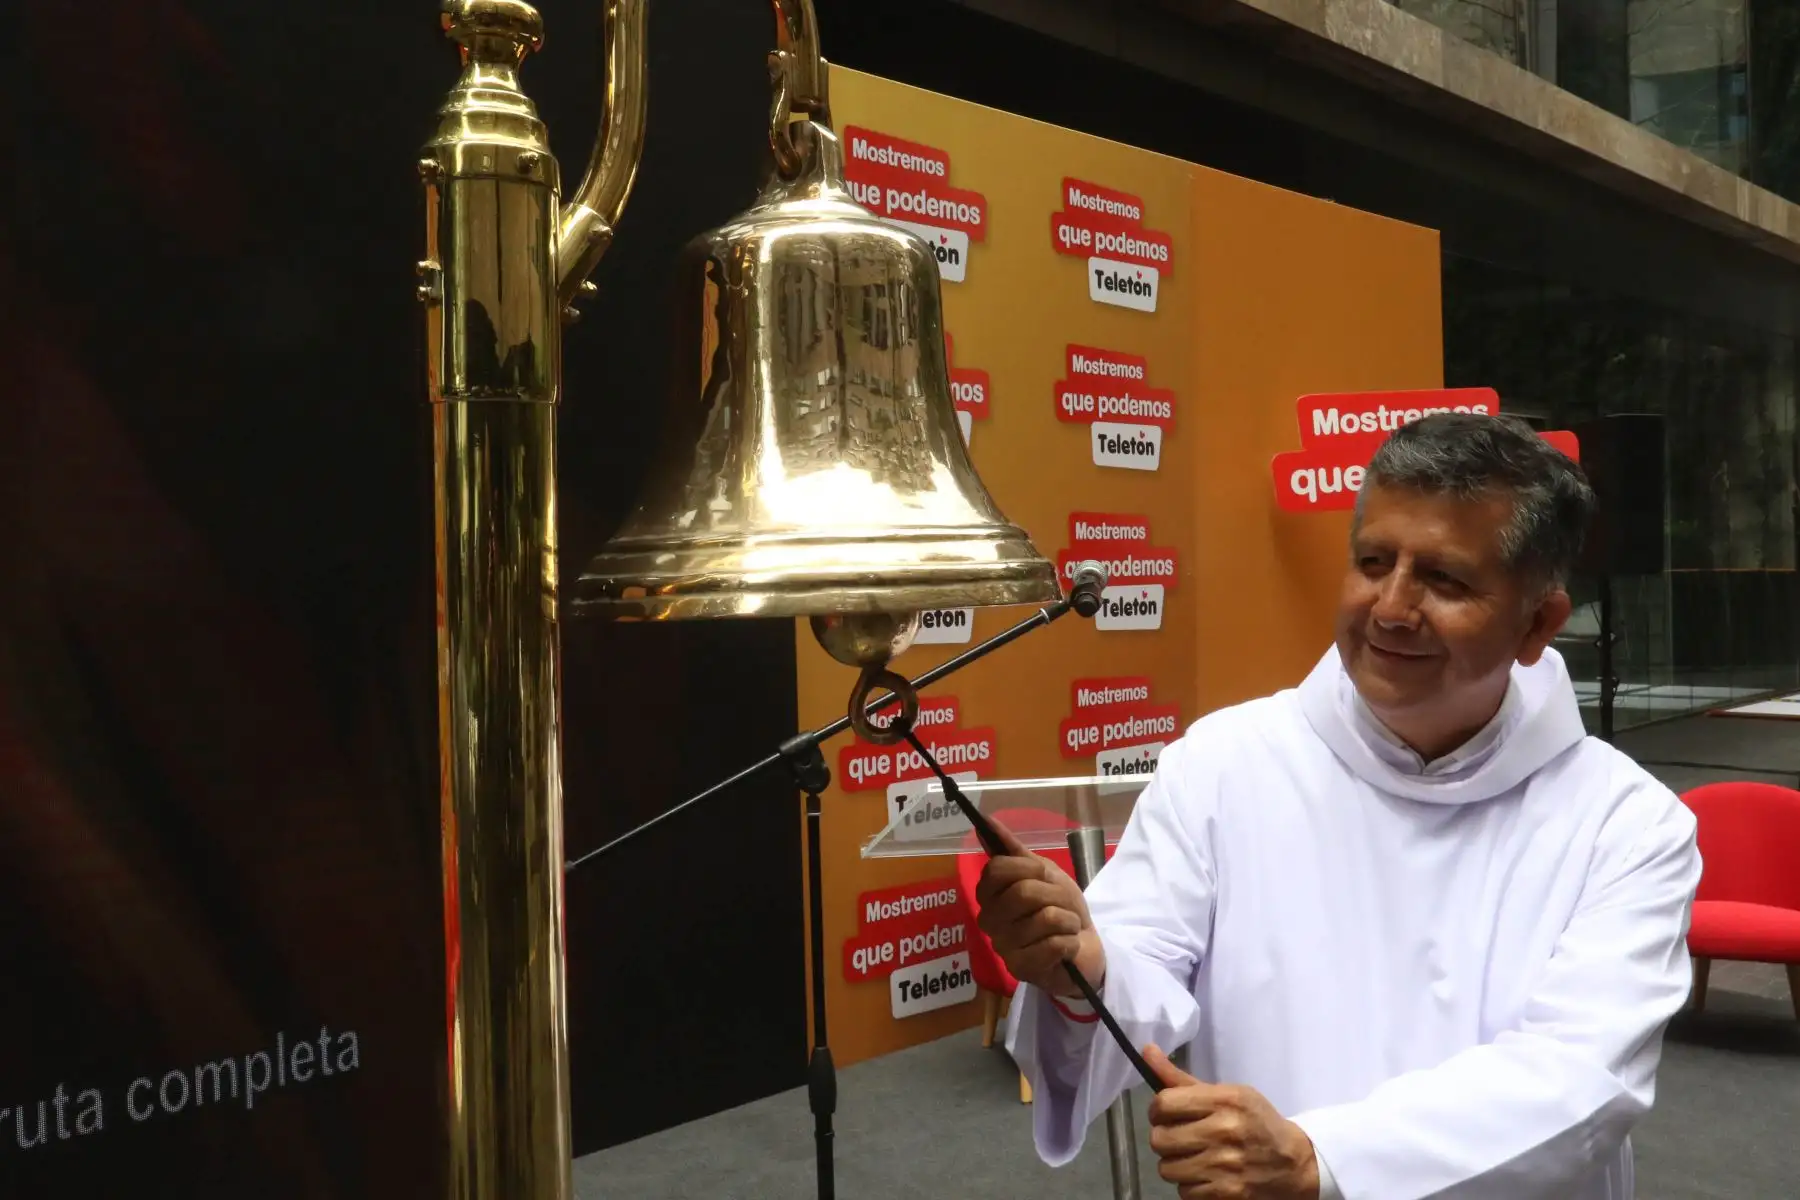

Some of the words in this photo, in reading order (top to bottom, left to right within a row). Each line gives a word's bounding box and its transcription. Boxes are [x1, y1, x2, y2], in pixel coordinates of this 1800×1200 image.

[852, 137, 945, 177] Mostremos
[886, 188, 981, 225] podemos
[1068, 187, 1141, 220] Mostremos
[1058, 223, 1091, 248] que
[1095, 231, 1168, 261] podemos
[1072, 354, 1144, 380] Mostremos
[1062, 391, 1094, 416] que
[1098, 393, 1171, 419] podemos
[1290, 465, 1367, 503] que
[1075, 521, 1146, 540] Mostremos
[1077, 686, 1148, 707] Mostremos
[1067, 725, 1099, 751] que
[1103, 716, 1175, 747] podemos
[848, 753, 891, 784] que
[896, 741, 990, 778] podemos
[866, 888, 957, 923] Mostremos
[852, 941, 894, 974] que
[127, 1024, 360, 1121] completa
